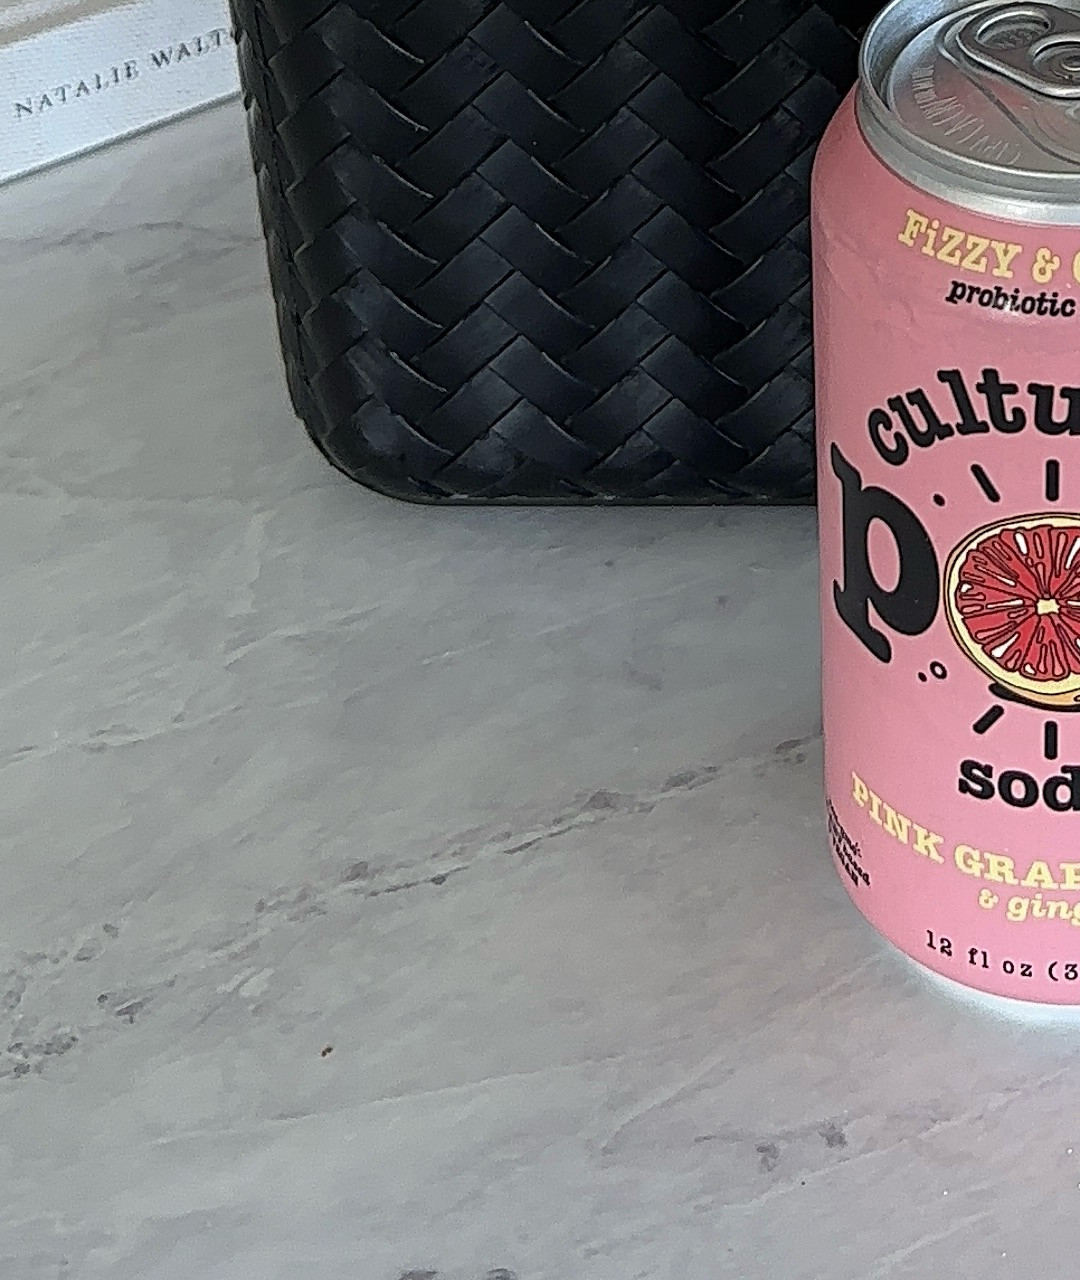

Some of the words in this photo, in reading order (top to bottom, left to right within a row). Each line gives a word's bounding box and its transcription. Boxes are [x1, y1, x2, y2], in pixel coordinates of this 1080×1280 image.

[150, 27, 228, 70] WALT
[1032, 247, 1061, 283] &
[945, 279, 1077, 318] probiotic
[851, 770, 945, 864] PINK
[977, 888, 999, 909] &
[926, 930, 953, 957] 12
[967, 947, 990, 969] fl
[1002, 960, 1033, 978] oz
